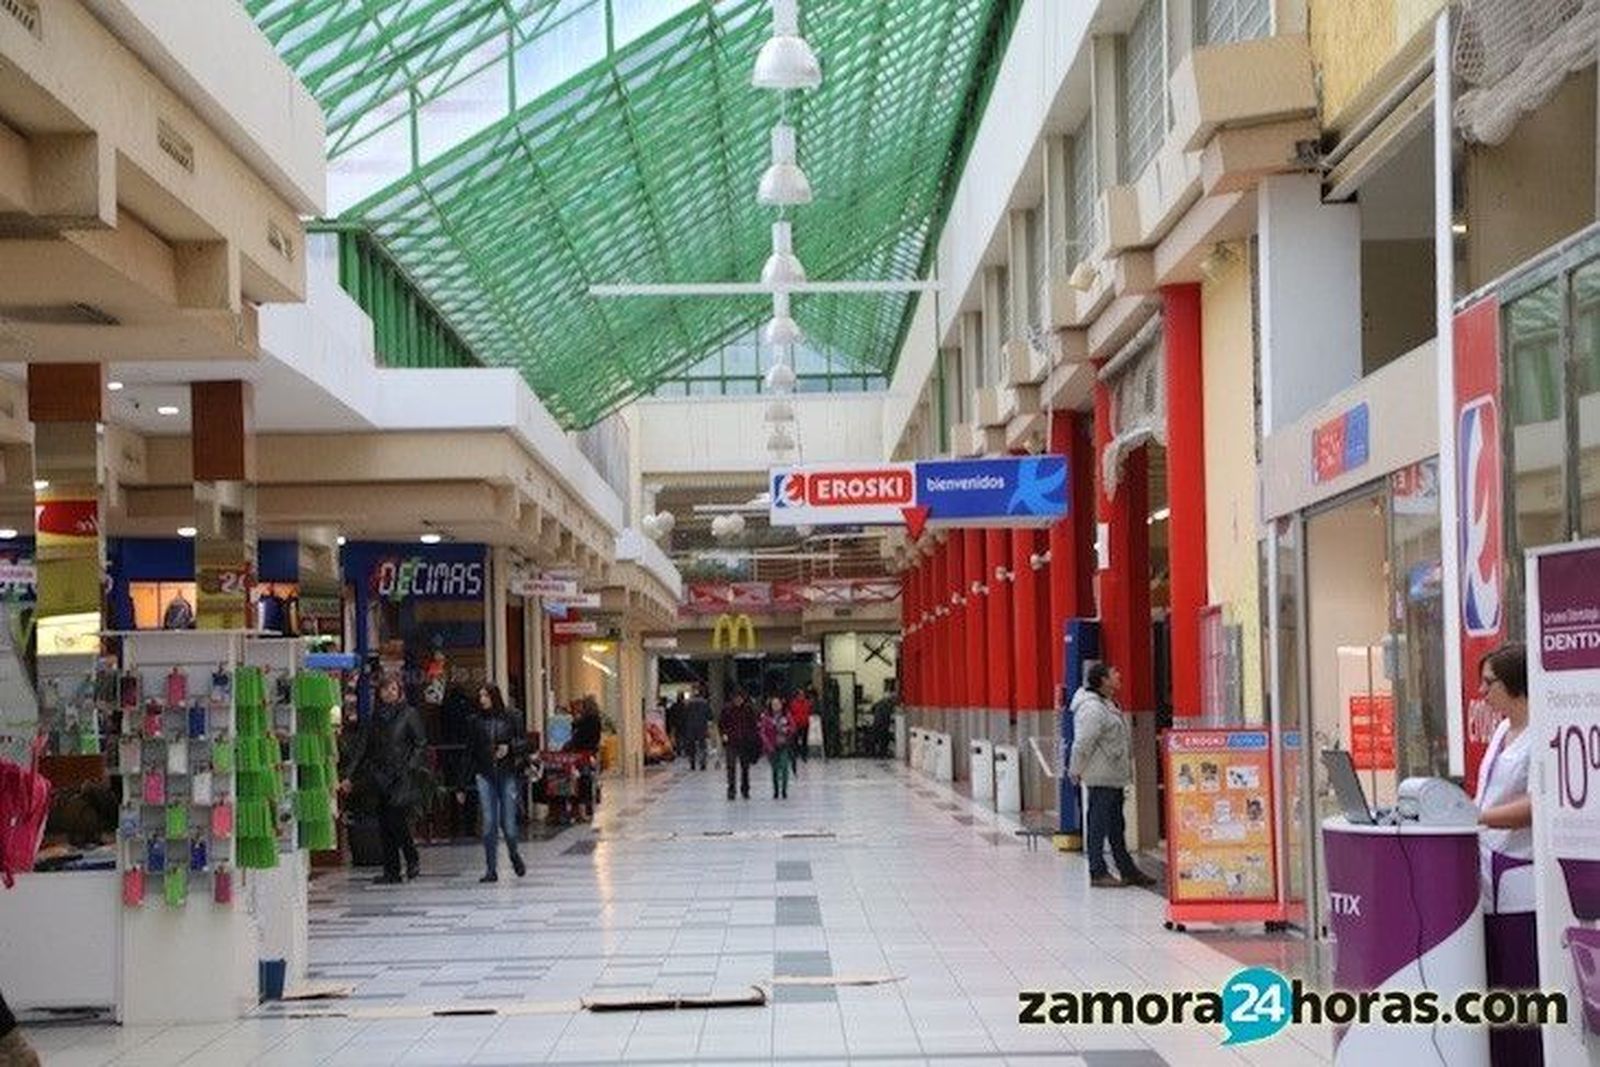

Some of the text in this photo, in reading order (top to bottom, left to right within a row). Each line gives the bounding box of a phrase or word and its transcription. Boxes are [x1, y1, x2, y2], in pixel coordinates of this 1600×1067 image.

[816, 477, 904, 500] EROSKI
[926, 474, 1005, 493] bienvenidos
[378, 561, 481, 595] DECIMAS
[1328, 892, 1361, 917] TIX
